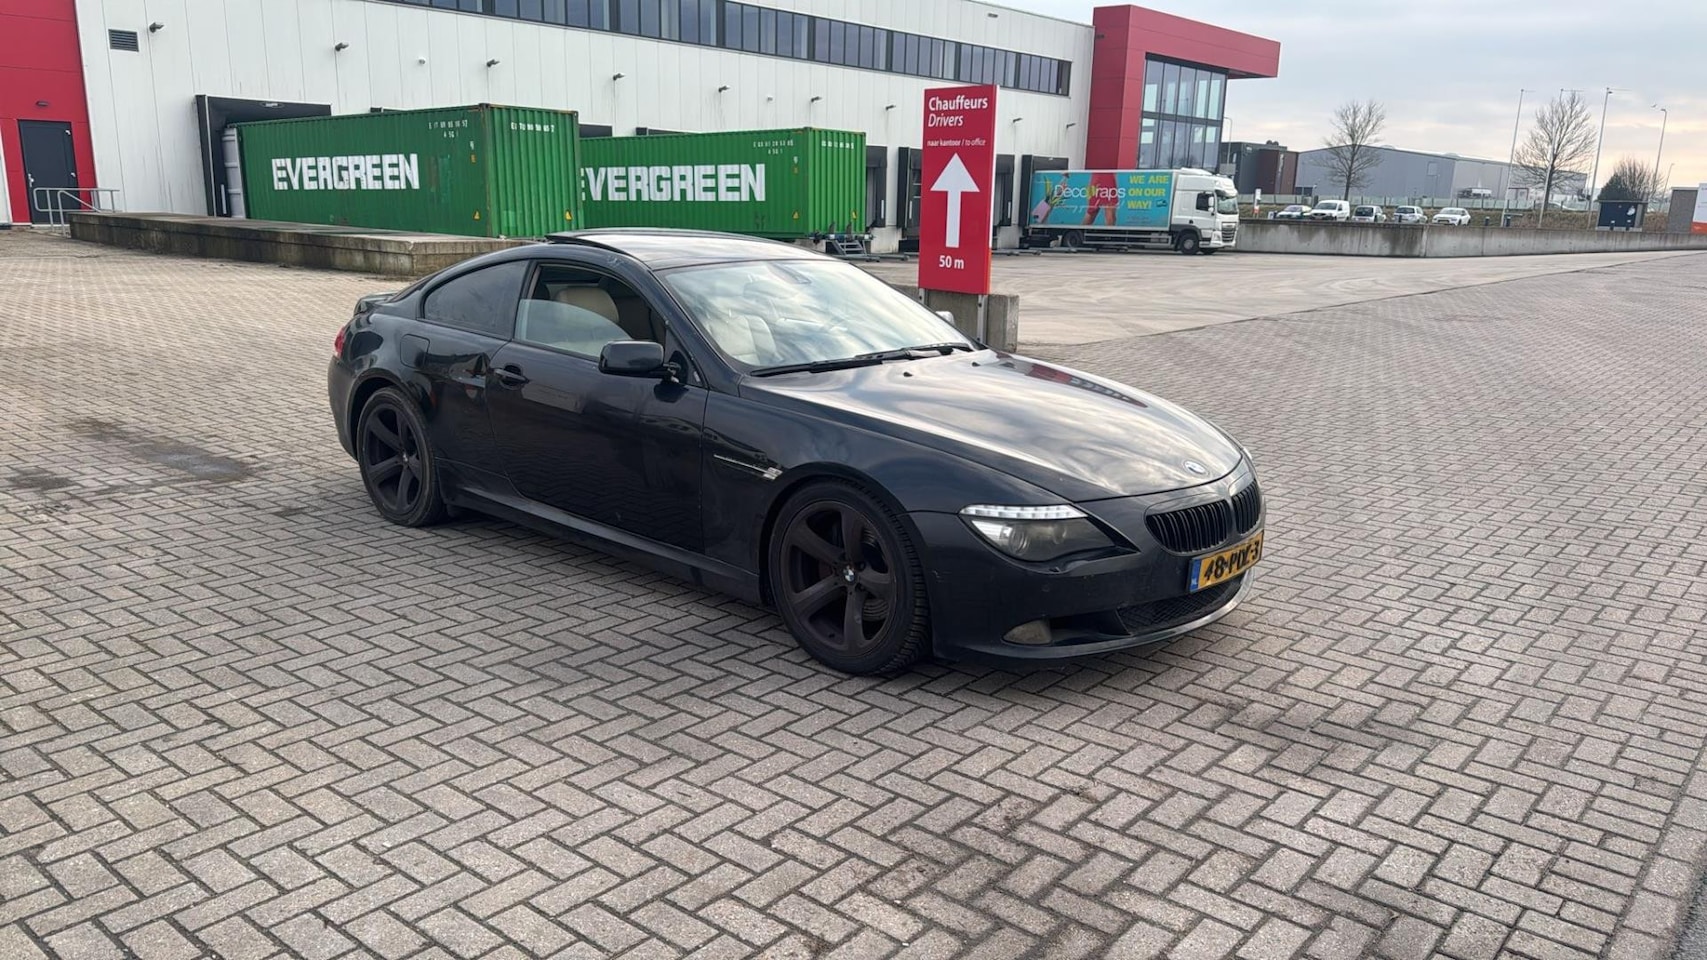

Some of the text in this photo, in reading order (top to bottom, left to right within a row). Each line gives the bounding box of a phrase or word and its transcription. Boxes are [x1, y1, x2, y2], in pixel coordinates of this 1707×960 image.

[928, 95, 988, 110] Chauffeurs
[928, 113, 963, 127] Drivers
[271, 153, 420, 190] EVERGREEN
[1129, 174, 1170, 184] WE ARE
[1128, 187, 1166, 197] ON OUR
[939, 255, 965, 269] 50 m
